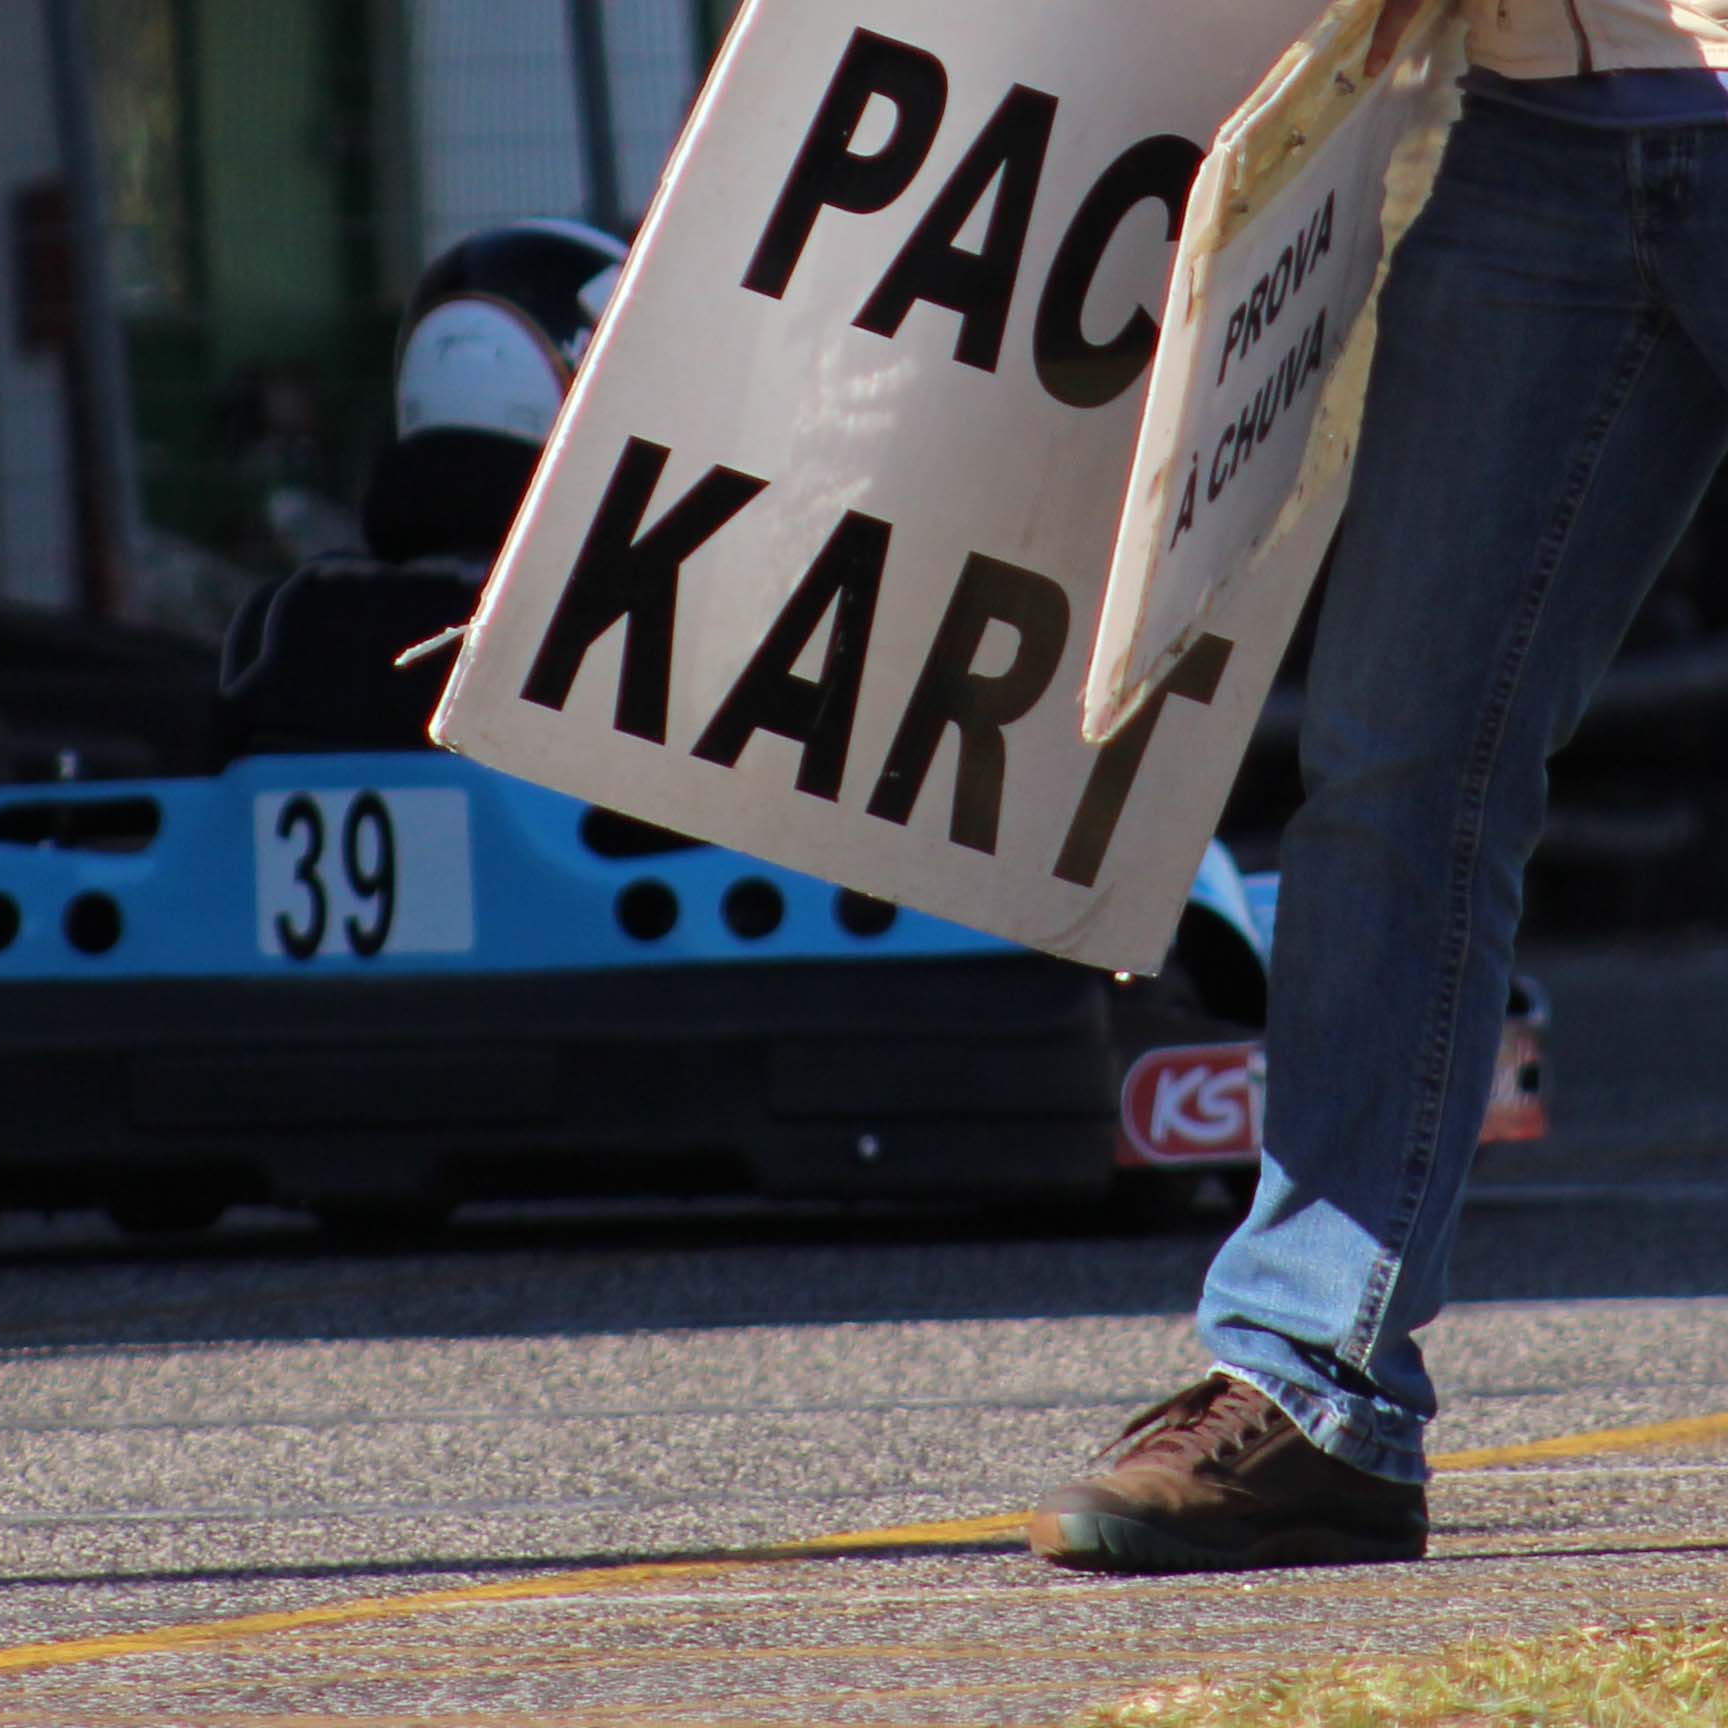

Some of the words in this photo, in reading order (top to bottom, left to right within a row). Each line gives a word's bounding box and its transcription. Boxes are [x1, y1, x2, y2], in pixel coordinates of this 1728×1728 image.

[739, 26, 1206, 410] PAC
[1216, 188, 1336, 388] PROVA
[1207, 307, 1327, 504] CHUVA
[519, 435, 1236, 889] KART
[274, 787, 398, 962] 39
